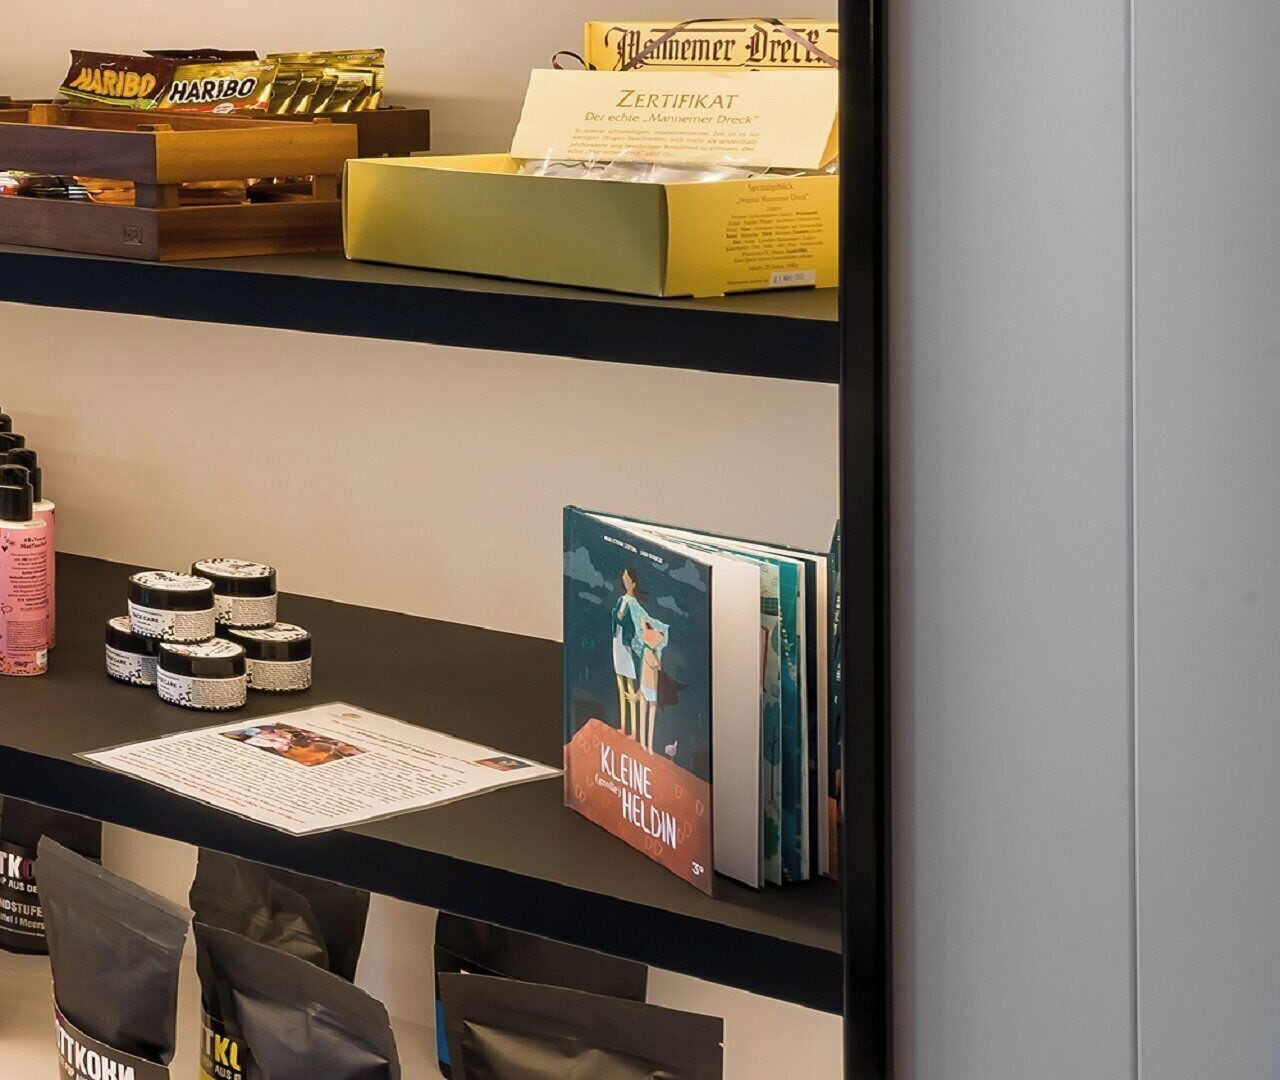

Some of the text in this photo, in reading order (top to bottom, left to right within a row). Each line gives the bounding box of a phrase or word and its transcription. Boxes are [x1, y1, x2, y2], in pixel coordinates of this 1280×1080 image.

[68, 66, 158, 99] HARIBO
[168, 76, 260, 105] HARIBO
[615, 89, 740, 110] ZERTIFIKAT
[584, 111, 605, 122] Der
[607, 113, 640, 123] echte
[144, 615, 160, 624] CARE
[600, 741, 653, 800] KLEINE
[620, 787, 678, 850] HELDIN
[7, 879, 38, 894] AUS DE
[19, 917, 46, 930] Meers
